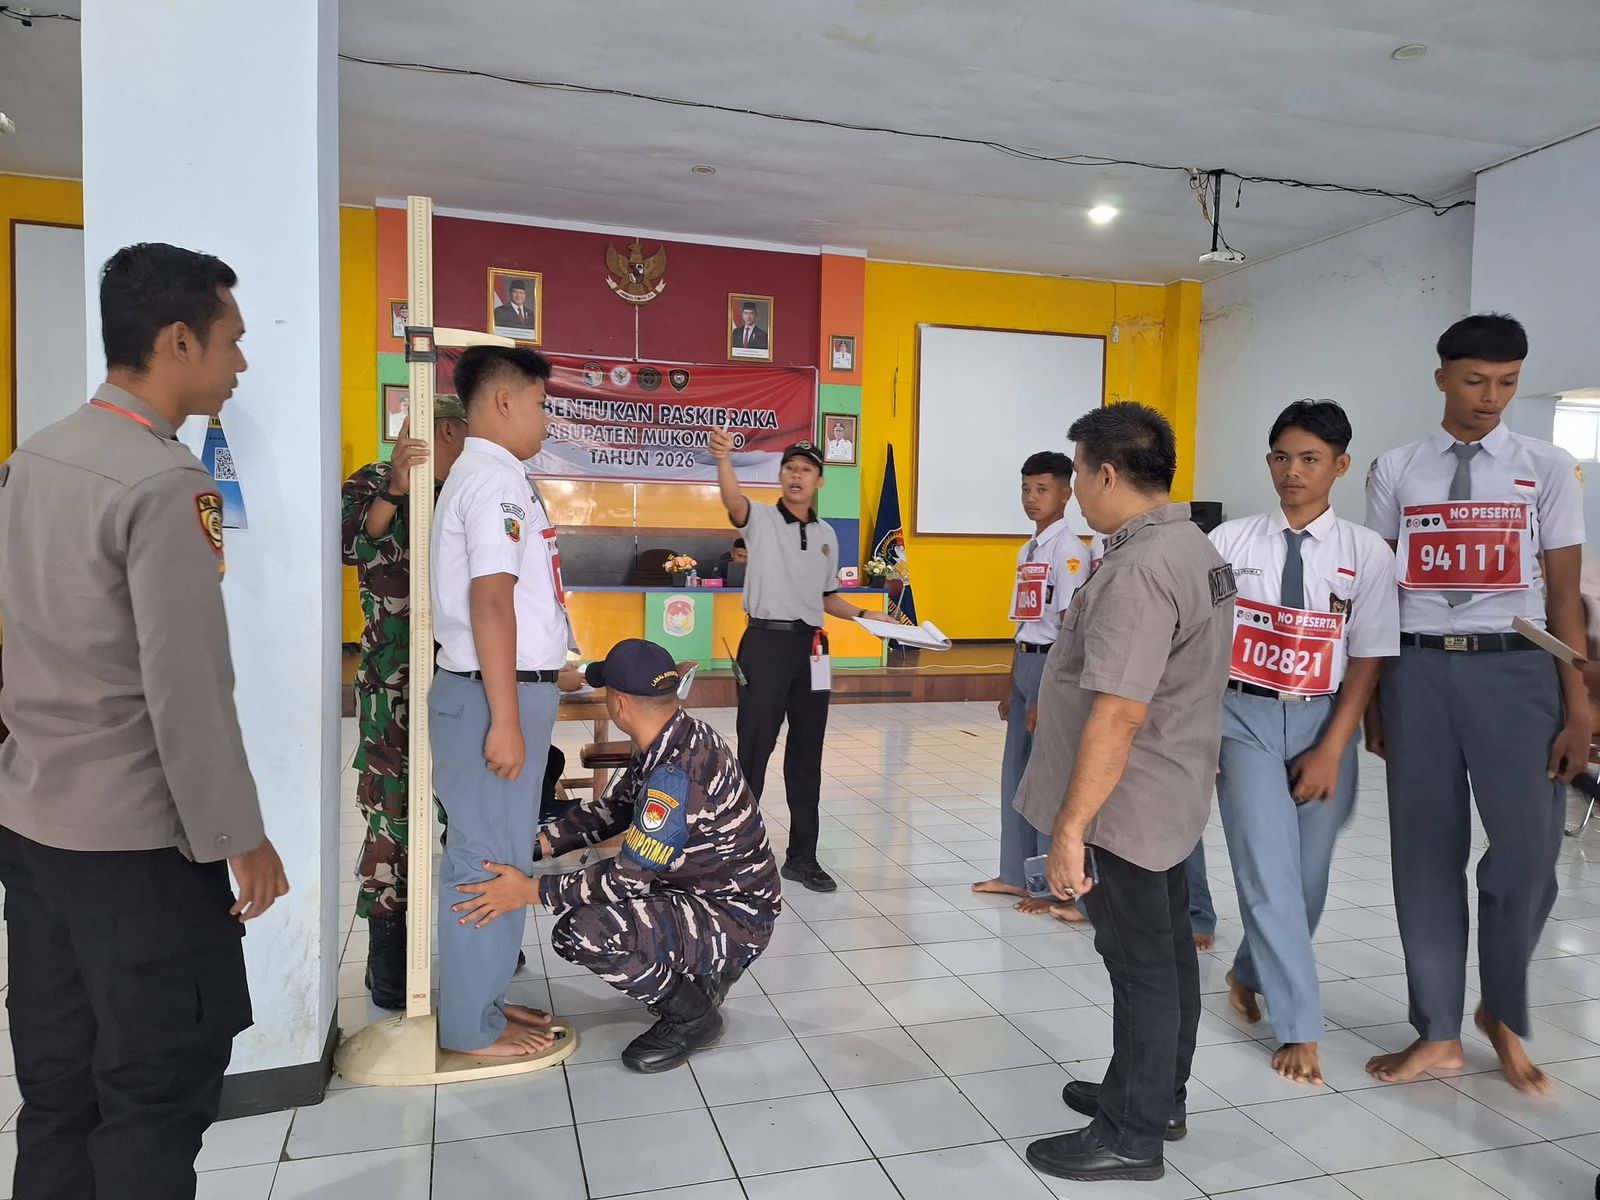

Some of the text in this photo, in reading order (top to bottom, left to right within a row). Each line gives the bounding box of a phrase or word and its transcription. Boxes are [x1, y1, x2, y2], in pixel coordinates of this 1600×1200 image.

[658, 404, 779, 429] PASKIBRAKA
[641, 428, 745, 449] MUKOMO
[589, 448, 695, 468] TAHUN 2026
[1450, 507, 1521, 520] NO PESERTA
[1421, 544, 1505, 571] 94111
[1277, 611, 1338, 630] NO PESERTA
[1242, 638, 1323, 678] 102821
